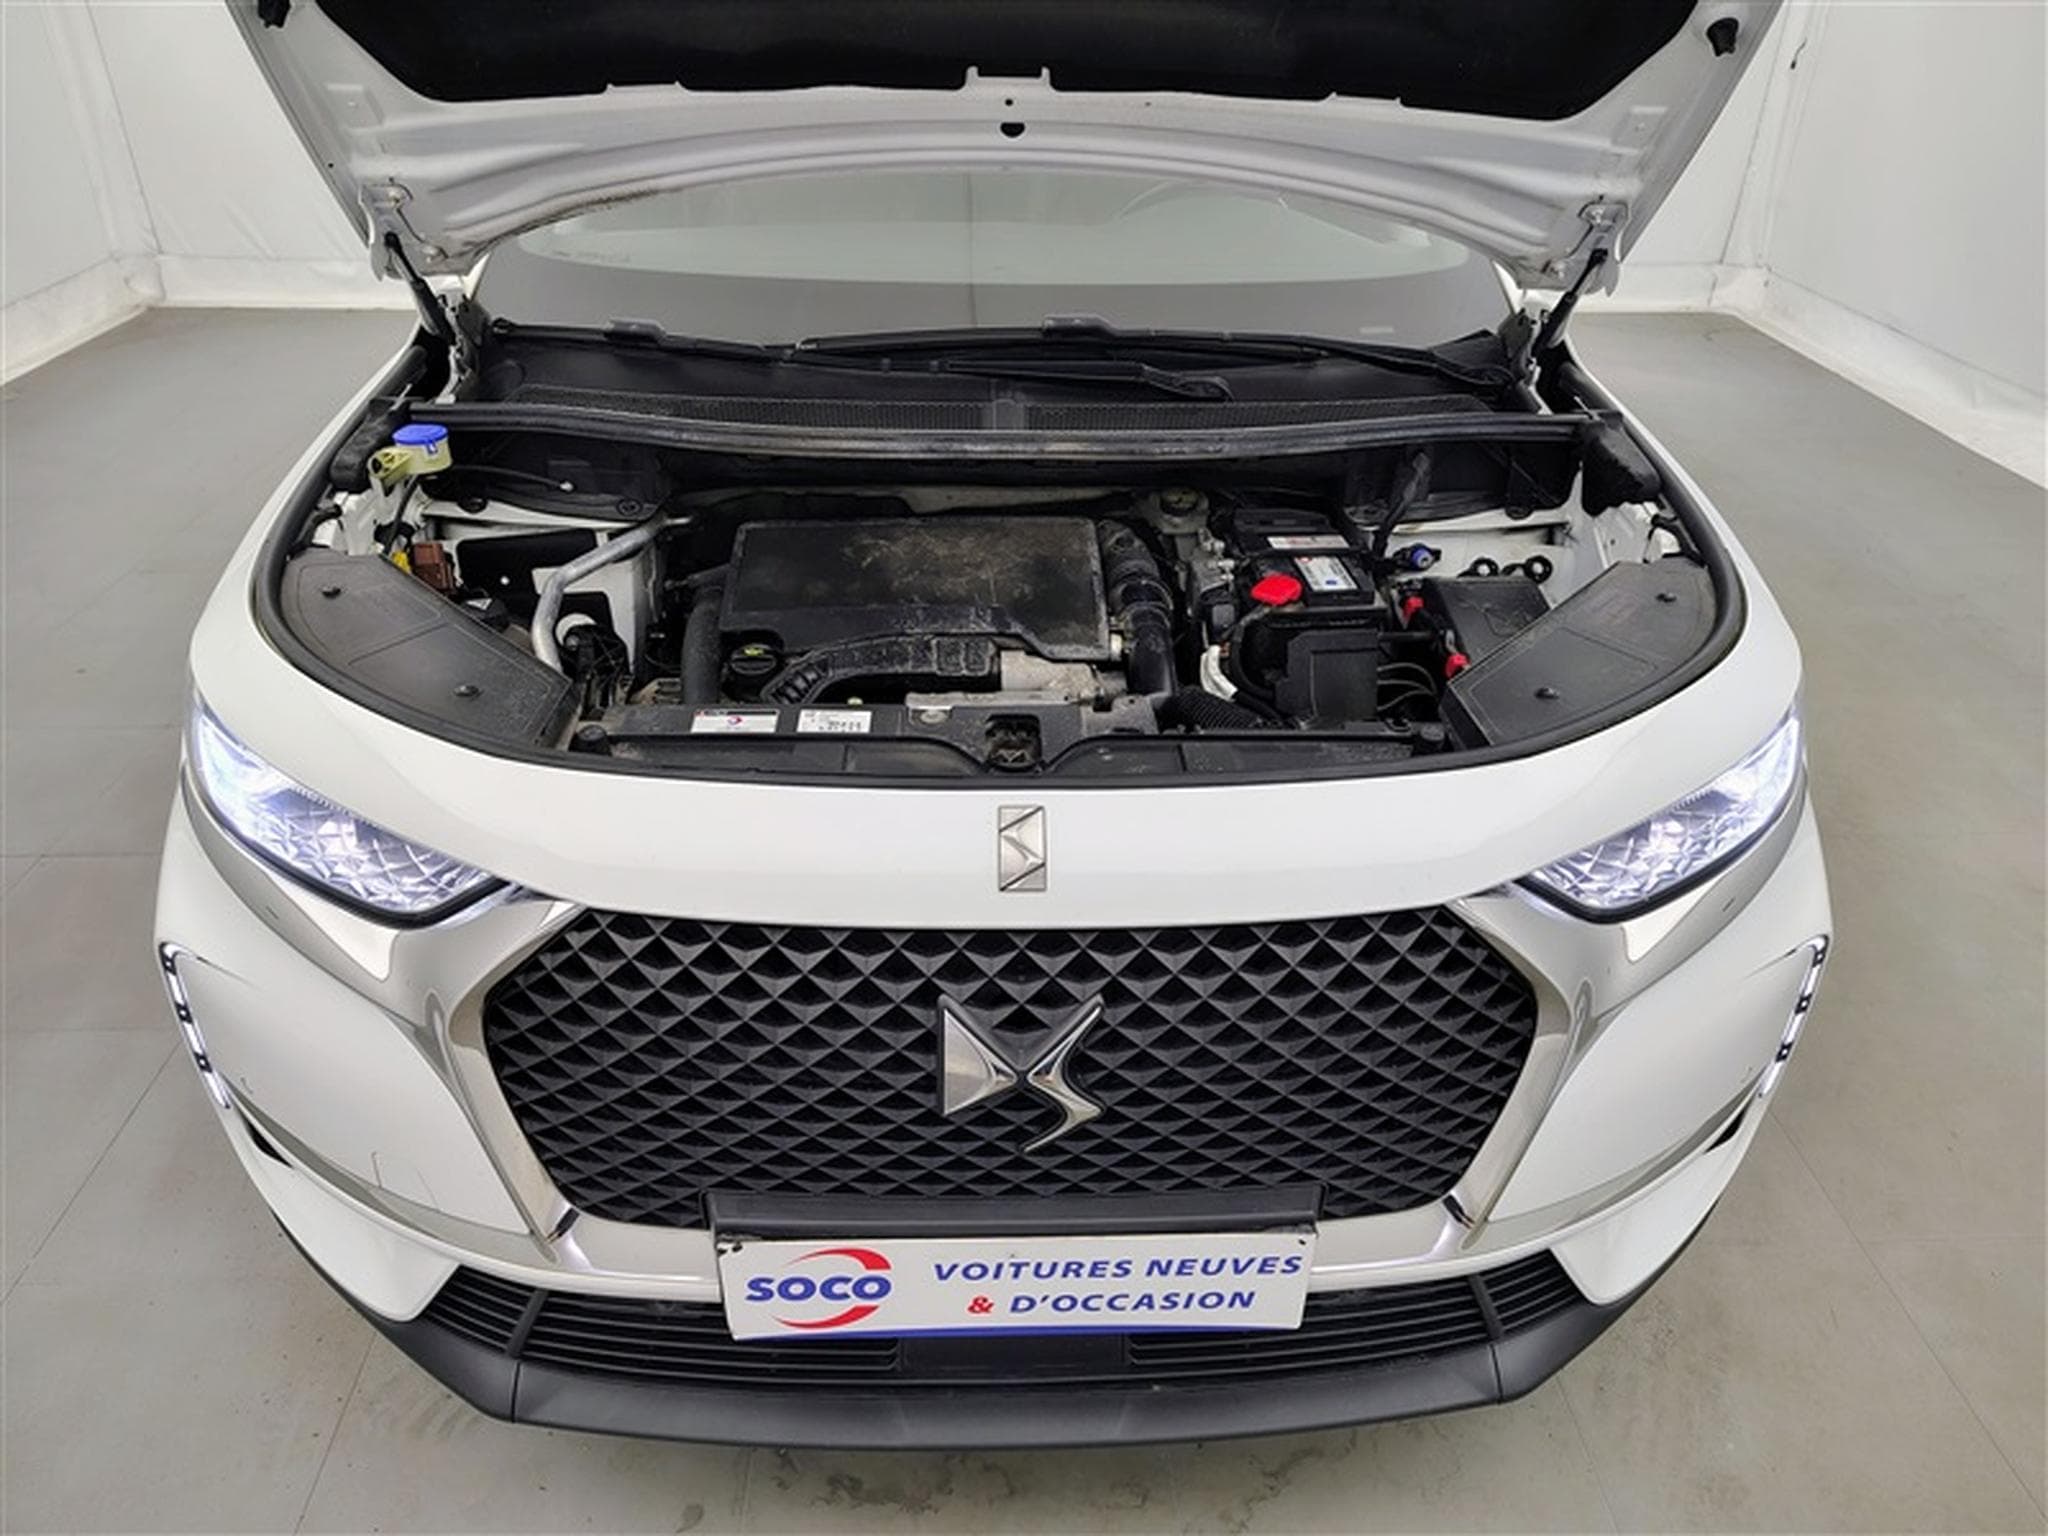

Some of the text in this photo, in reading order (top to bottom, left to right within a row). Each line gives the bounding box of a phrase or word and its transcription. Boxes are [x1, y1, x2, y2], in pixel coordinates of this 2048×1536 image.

[933, 1256, 1302, 1281] VOITURES NEUVES
[745, 1275, 892, 1302] SOCO
[967, 1291, 1256, 1314] & D'OCCASION
